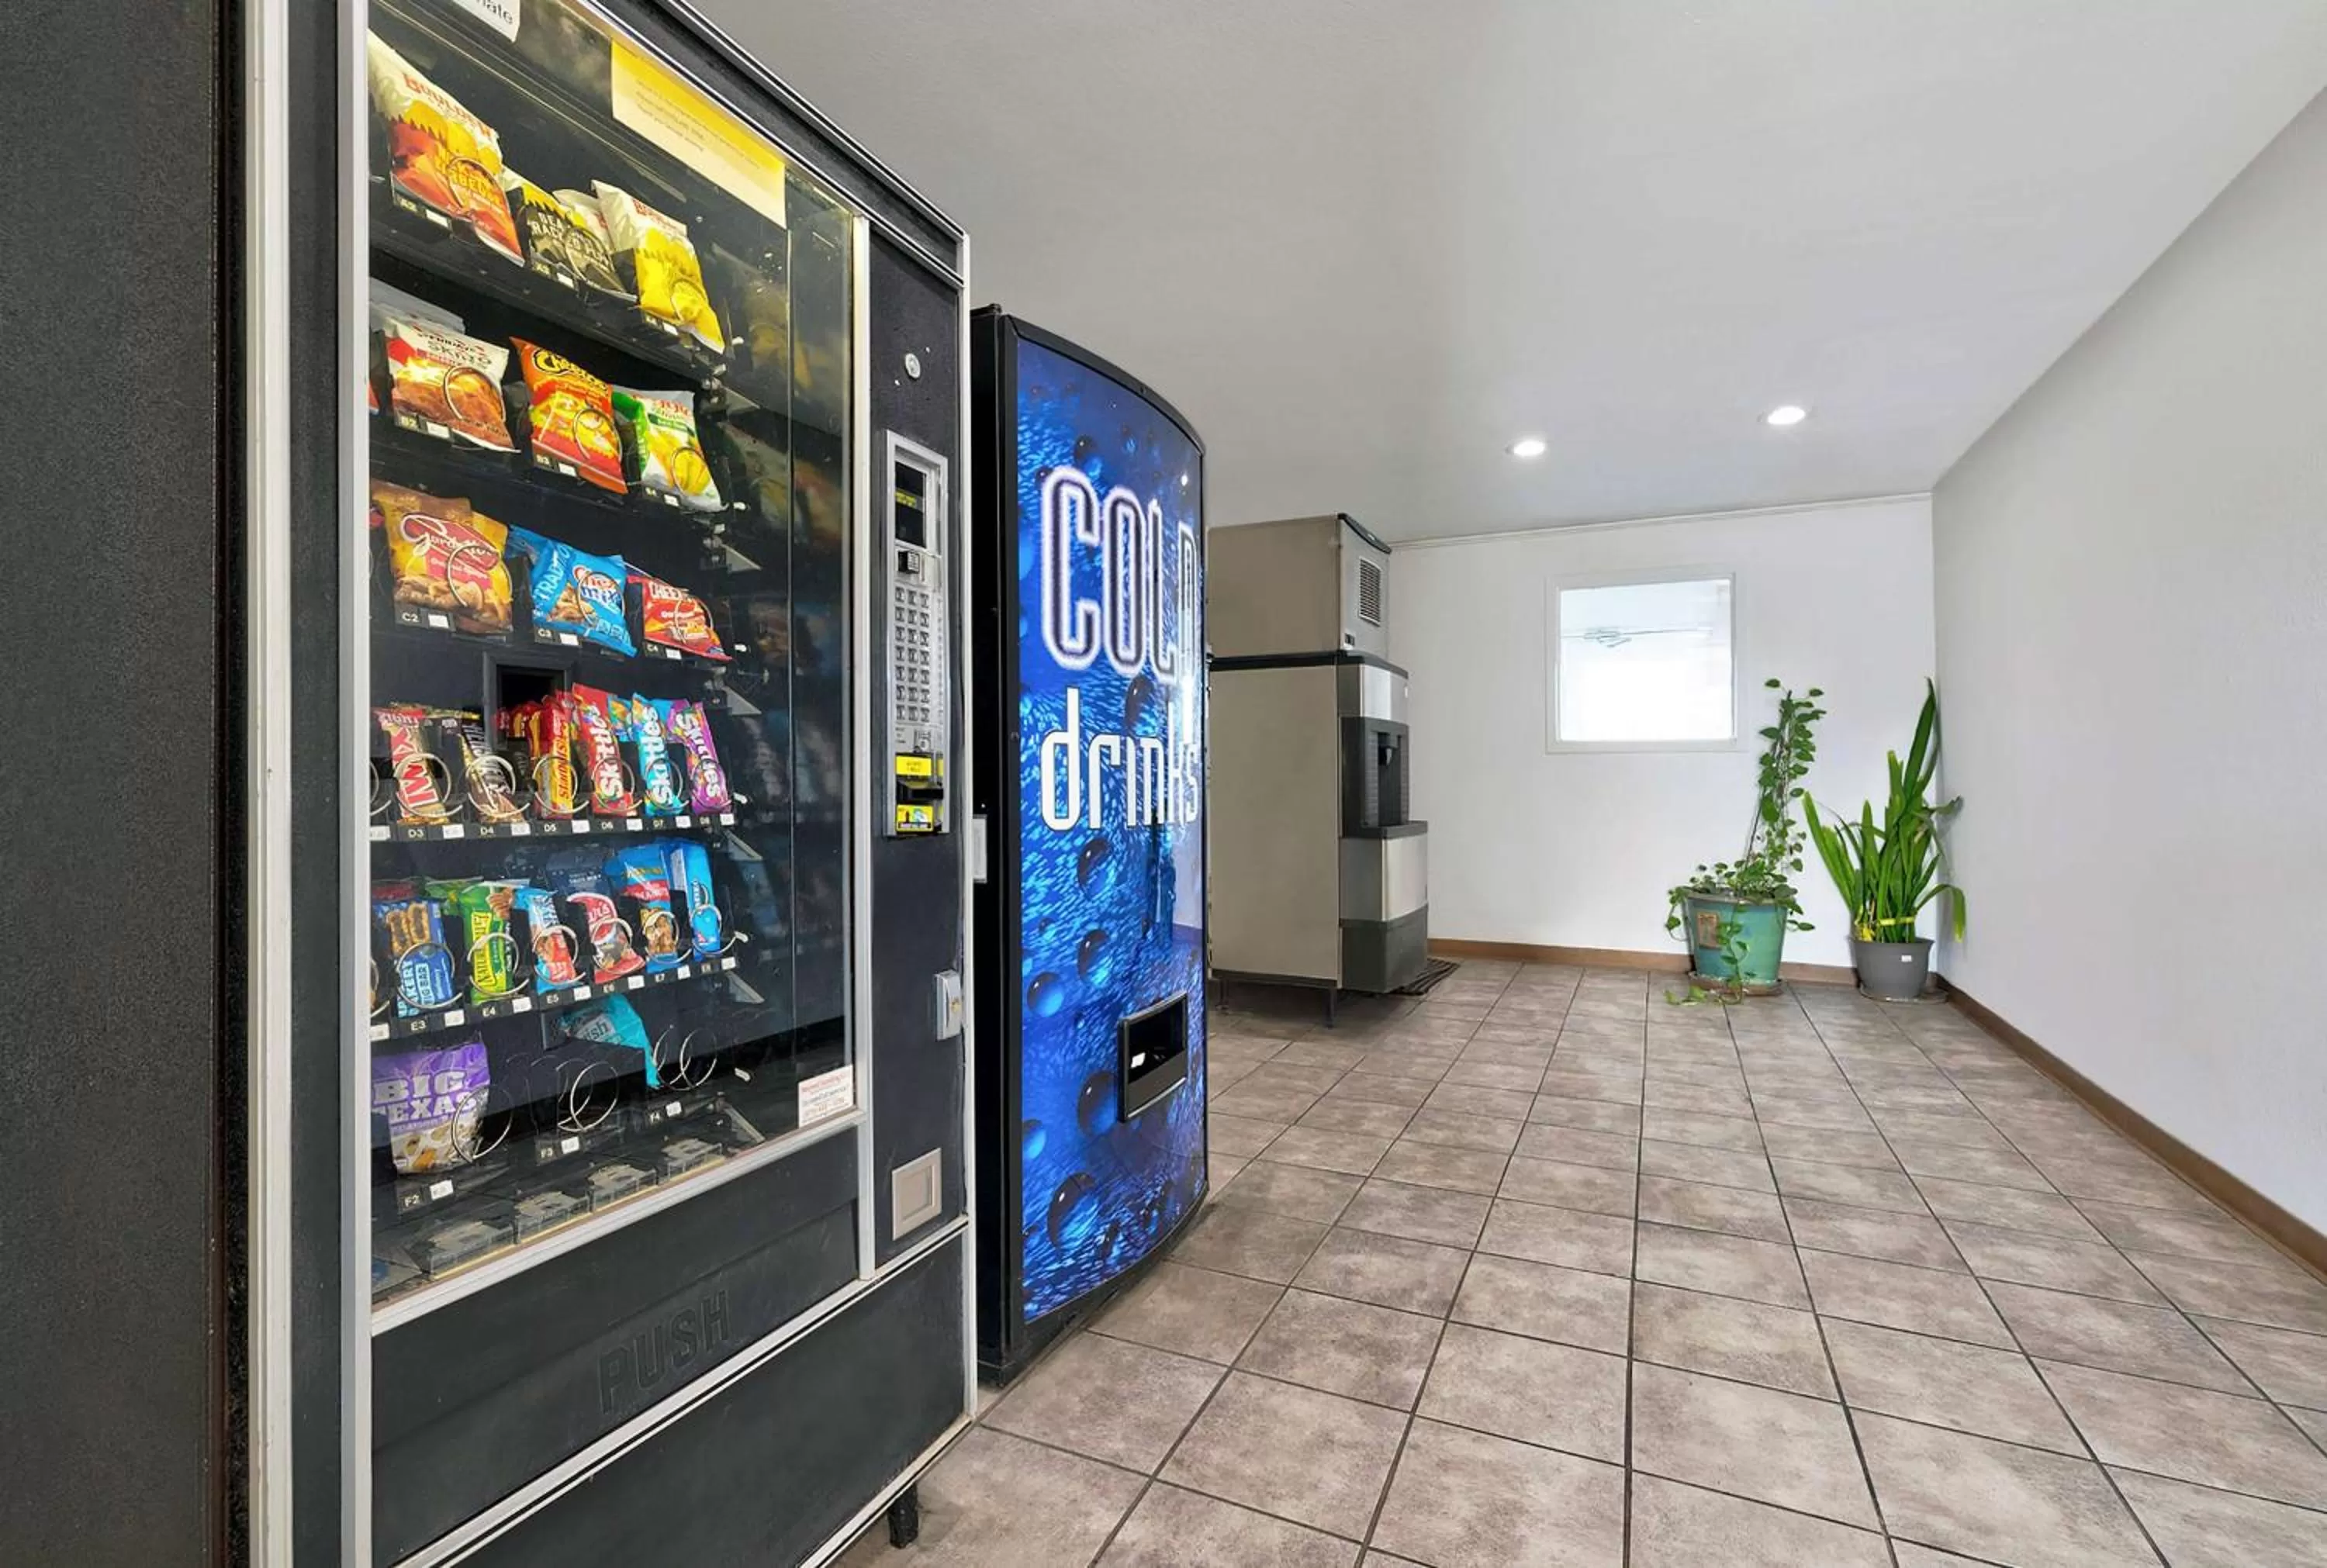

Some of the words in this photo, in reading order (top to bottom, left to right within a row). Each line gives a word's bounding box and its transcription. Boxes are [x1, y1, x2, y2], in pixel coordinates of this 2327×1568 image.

[1040, 467, 1198, 687] COLD
[402, 612, 419, 623] C2
[538, 628, 551, 638] C3
[647, 643, 659, 652] C4
[1039, 686, 1198, 831] drinks
[544, 823, 557, 833] D5
[600, 820, 614, 830] D6
[652, 818, 665, 827] D7
[408, 828, 424, 838] D3
[480, 827, 495, 836] D4
[603, 983, 615, 993] E6
[545, 994, 559, 1005] E5
[482, 1007, 496, 1018] E4
[410, 1020, 427, 1032] E3
[372, 1070, 466, 1104] BIG
[541, 1147, 553, 1159] F3
[404, 1194, 420, 1207] F2
[598, 1290, 731, 1416] PUSH
